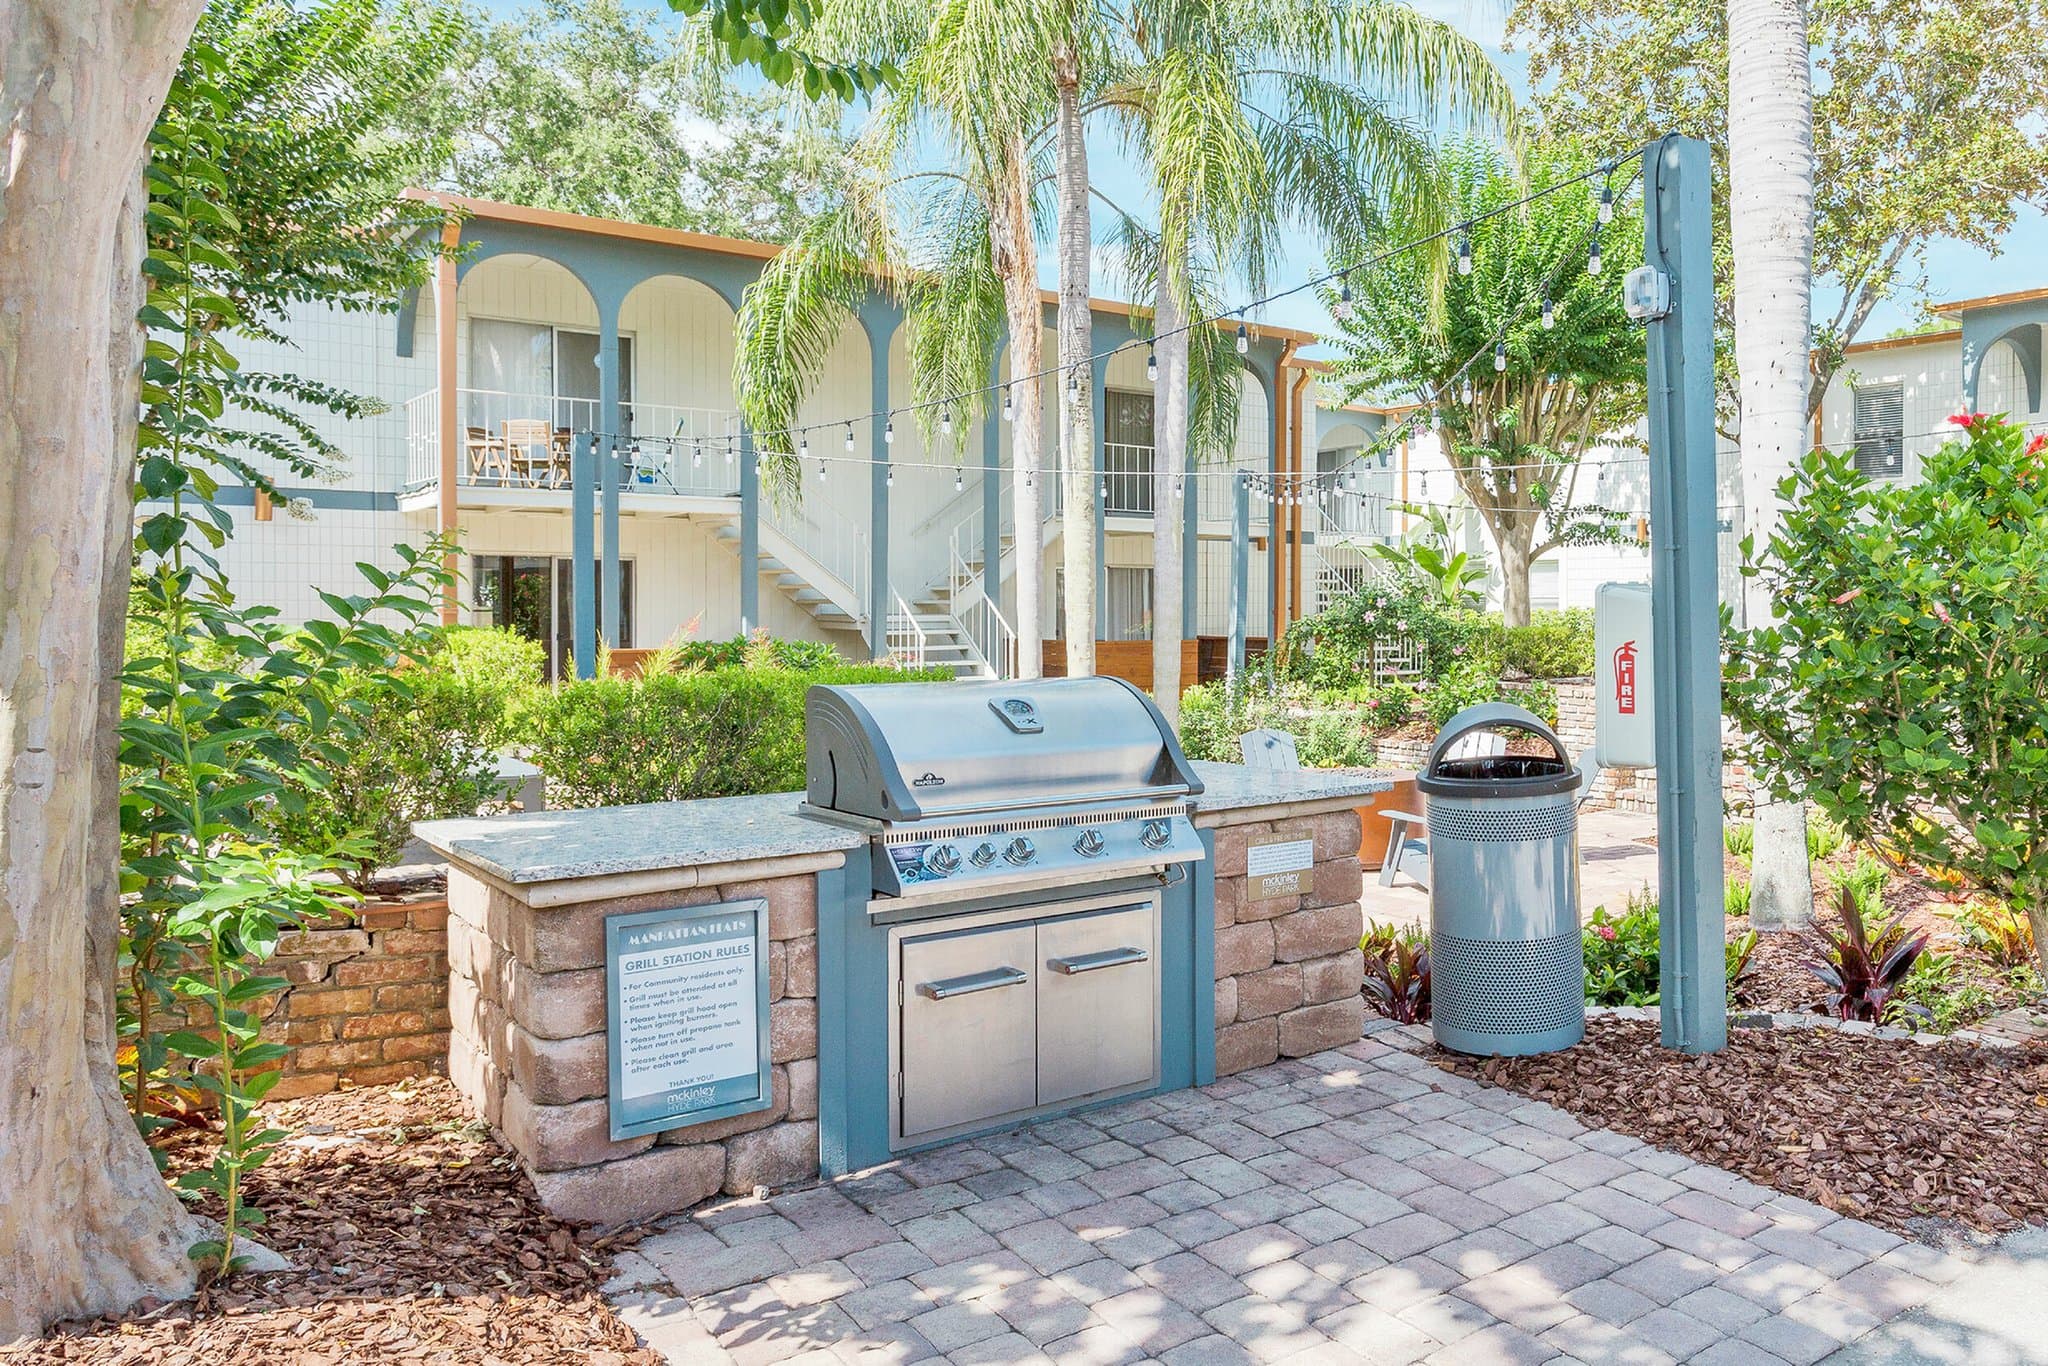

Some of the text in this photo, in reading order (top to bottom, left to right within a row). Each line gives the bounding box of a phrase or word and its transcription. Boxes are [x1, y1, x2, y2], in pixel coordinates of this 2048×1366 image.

[1621, 660, 1632, 708] FIRE
[629, 926, 707, 945] MANHATTAN
[625, 944, 750, 971] GRILL STATION RULES
[644, 976, 688, 988] Community
[691, 971, 724, 980] residents
[629, 995, 646, 1003] Grill
[681, 983, 715, 994] attended
[728, 979, 737, 987] all
[629, 1003, 650, 1011] times
[653, 999, 675, 1007] when
[630, 1001, 737, 1024] Please keep grill hood open
[630, 1019, 741, 1044] Please turn off propane tank
[631, 1012, 718, 1032] when igniting burners.
[631, 1043, 653, 1052] when
[631, 1041, 733, 1065] Please clean grill and area
[631, 1065, 650, 1074] after
[653, 1061, 671, 1070] each
[668, 1073, 714, 1088] THANK YOU!
[667, 1085, 716, 1104] mckinley
[667, 1096, 716, 1113] HYDE PARK
